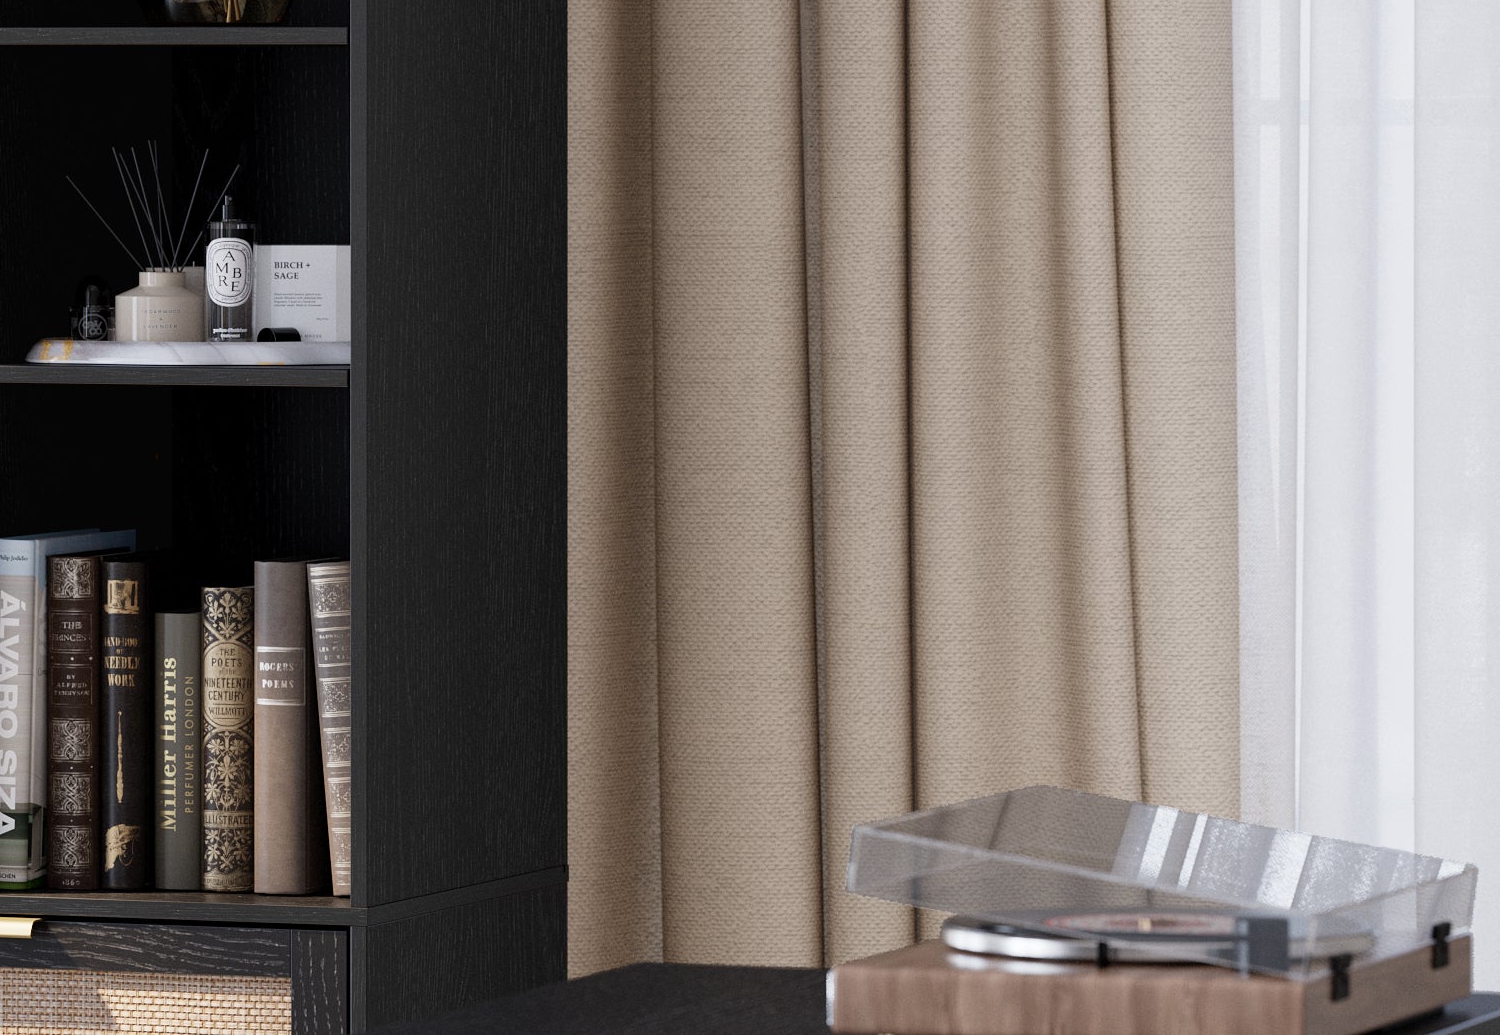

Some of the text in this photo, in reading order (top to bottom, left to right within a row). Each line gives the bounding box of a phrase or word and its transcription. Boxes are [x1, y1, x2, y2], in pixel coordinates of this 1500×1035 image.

[274, 261, 304, 269] BIRCH
[273, 271, 300, 280] SAGE
[61, 621, 83, 630] THE
[219, 648, 236, 656] THE
[104, 656, 141, 669] NEEDLE
[211, 658, 243, 668] POETS
[107, 674, 136, 687] WORK
[261, 678, 294, 689] POEMS
[208, 690, 245, 702] CENTURY
[160, 657, 177, 832] Miller Harris
[184, 676, 194, 814] PERFUMER LONDON
[205, 814, 253, 825] LLUSTRATED
